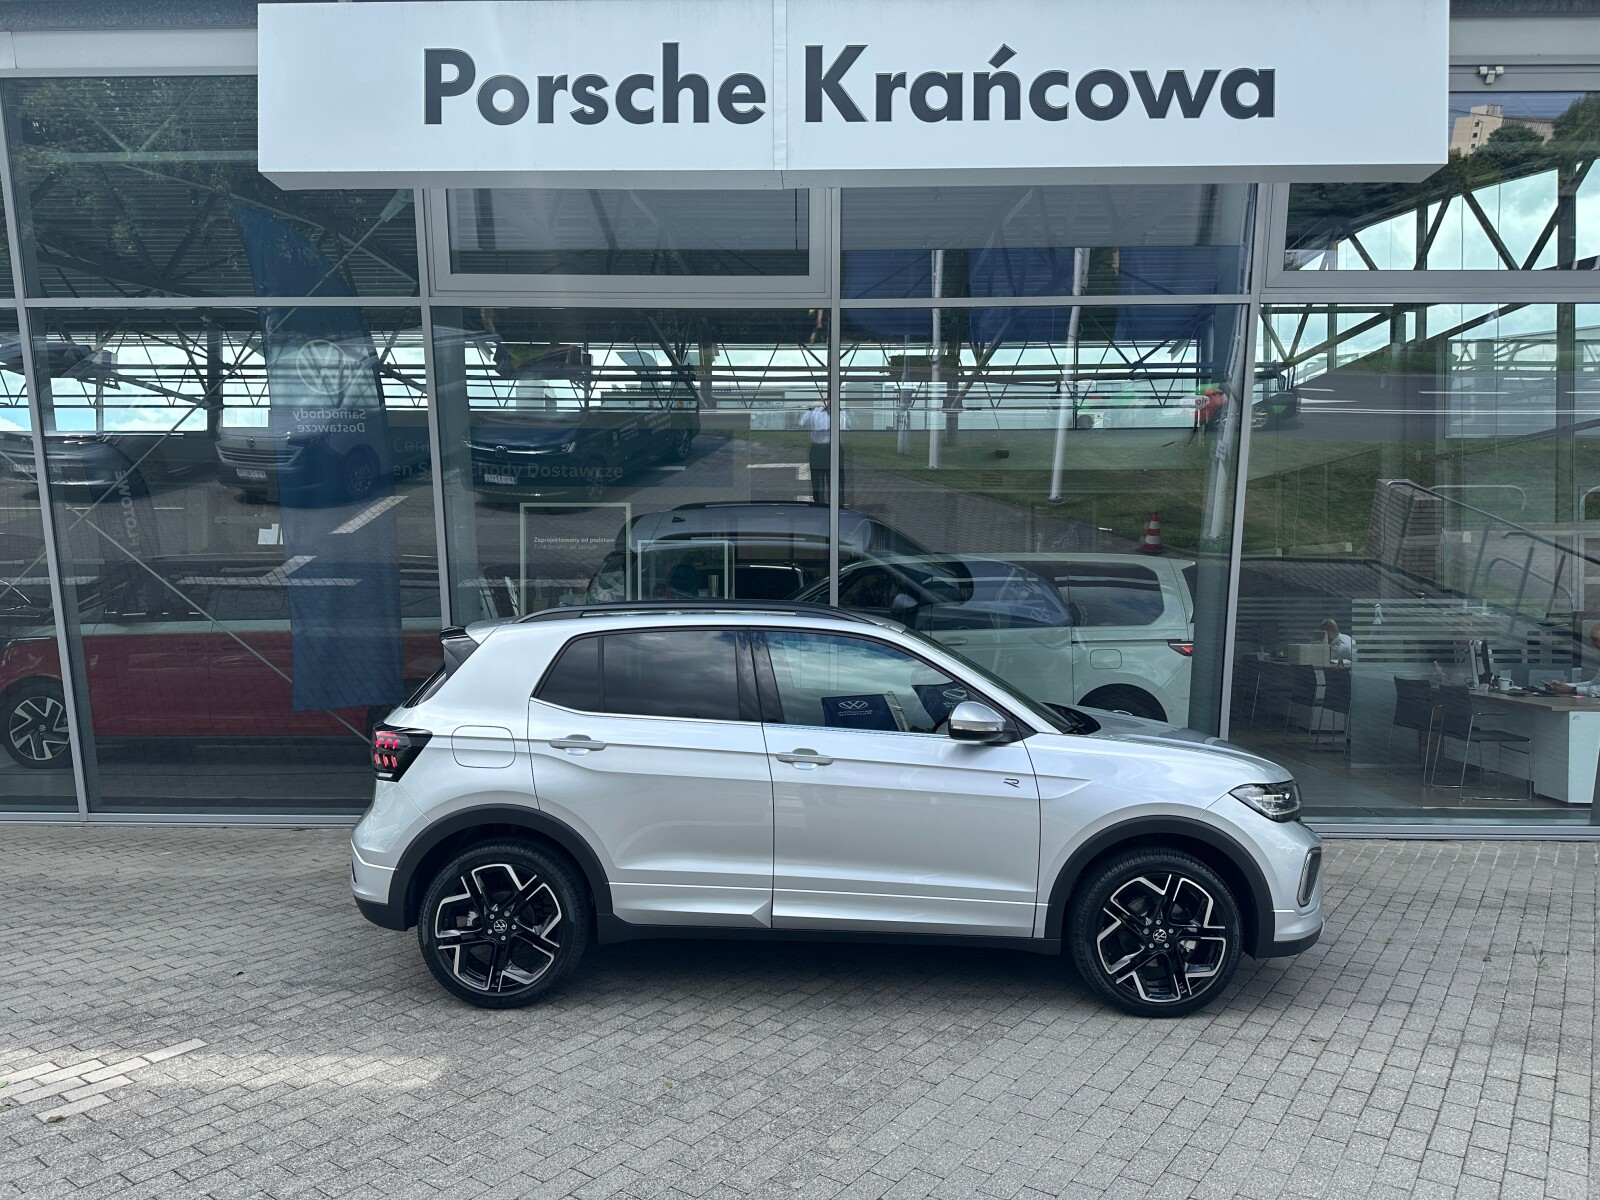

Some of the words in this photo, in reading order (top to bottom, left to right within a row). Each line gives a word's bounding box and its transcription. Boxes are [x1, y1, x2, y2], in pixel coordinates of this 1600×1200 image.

[423, 42, 767, 126] Porsche
[804, 43, 1276, 123] Krańcowa
[393, 436, 431, 453] Cent
[527, 462, 624, 478] Dostawcze
[533, 536, 580, 544] Zaprojektowany
[590, 536, 615, 544] podstaw
